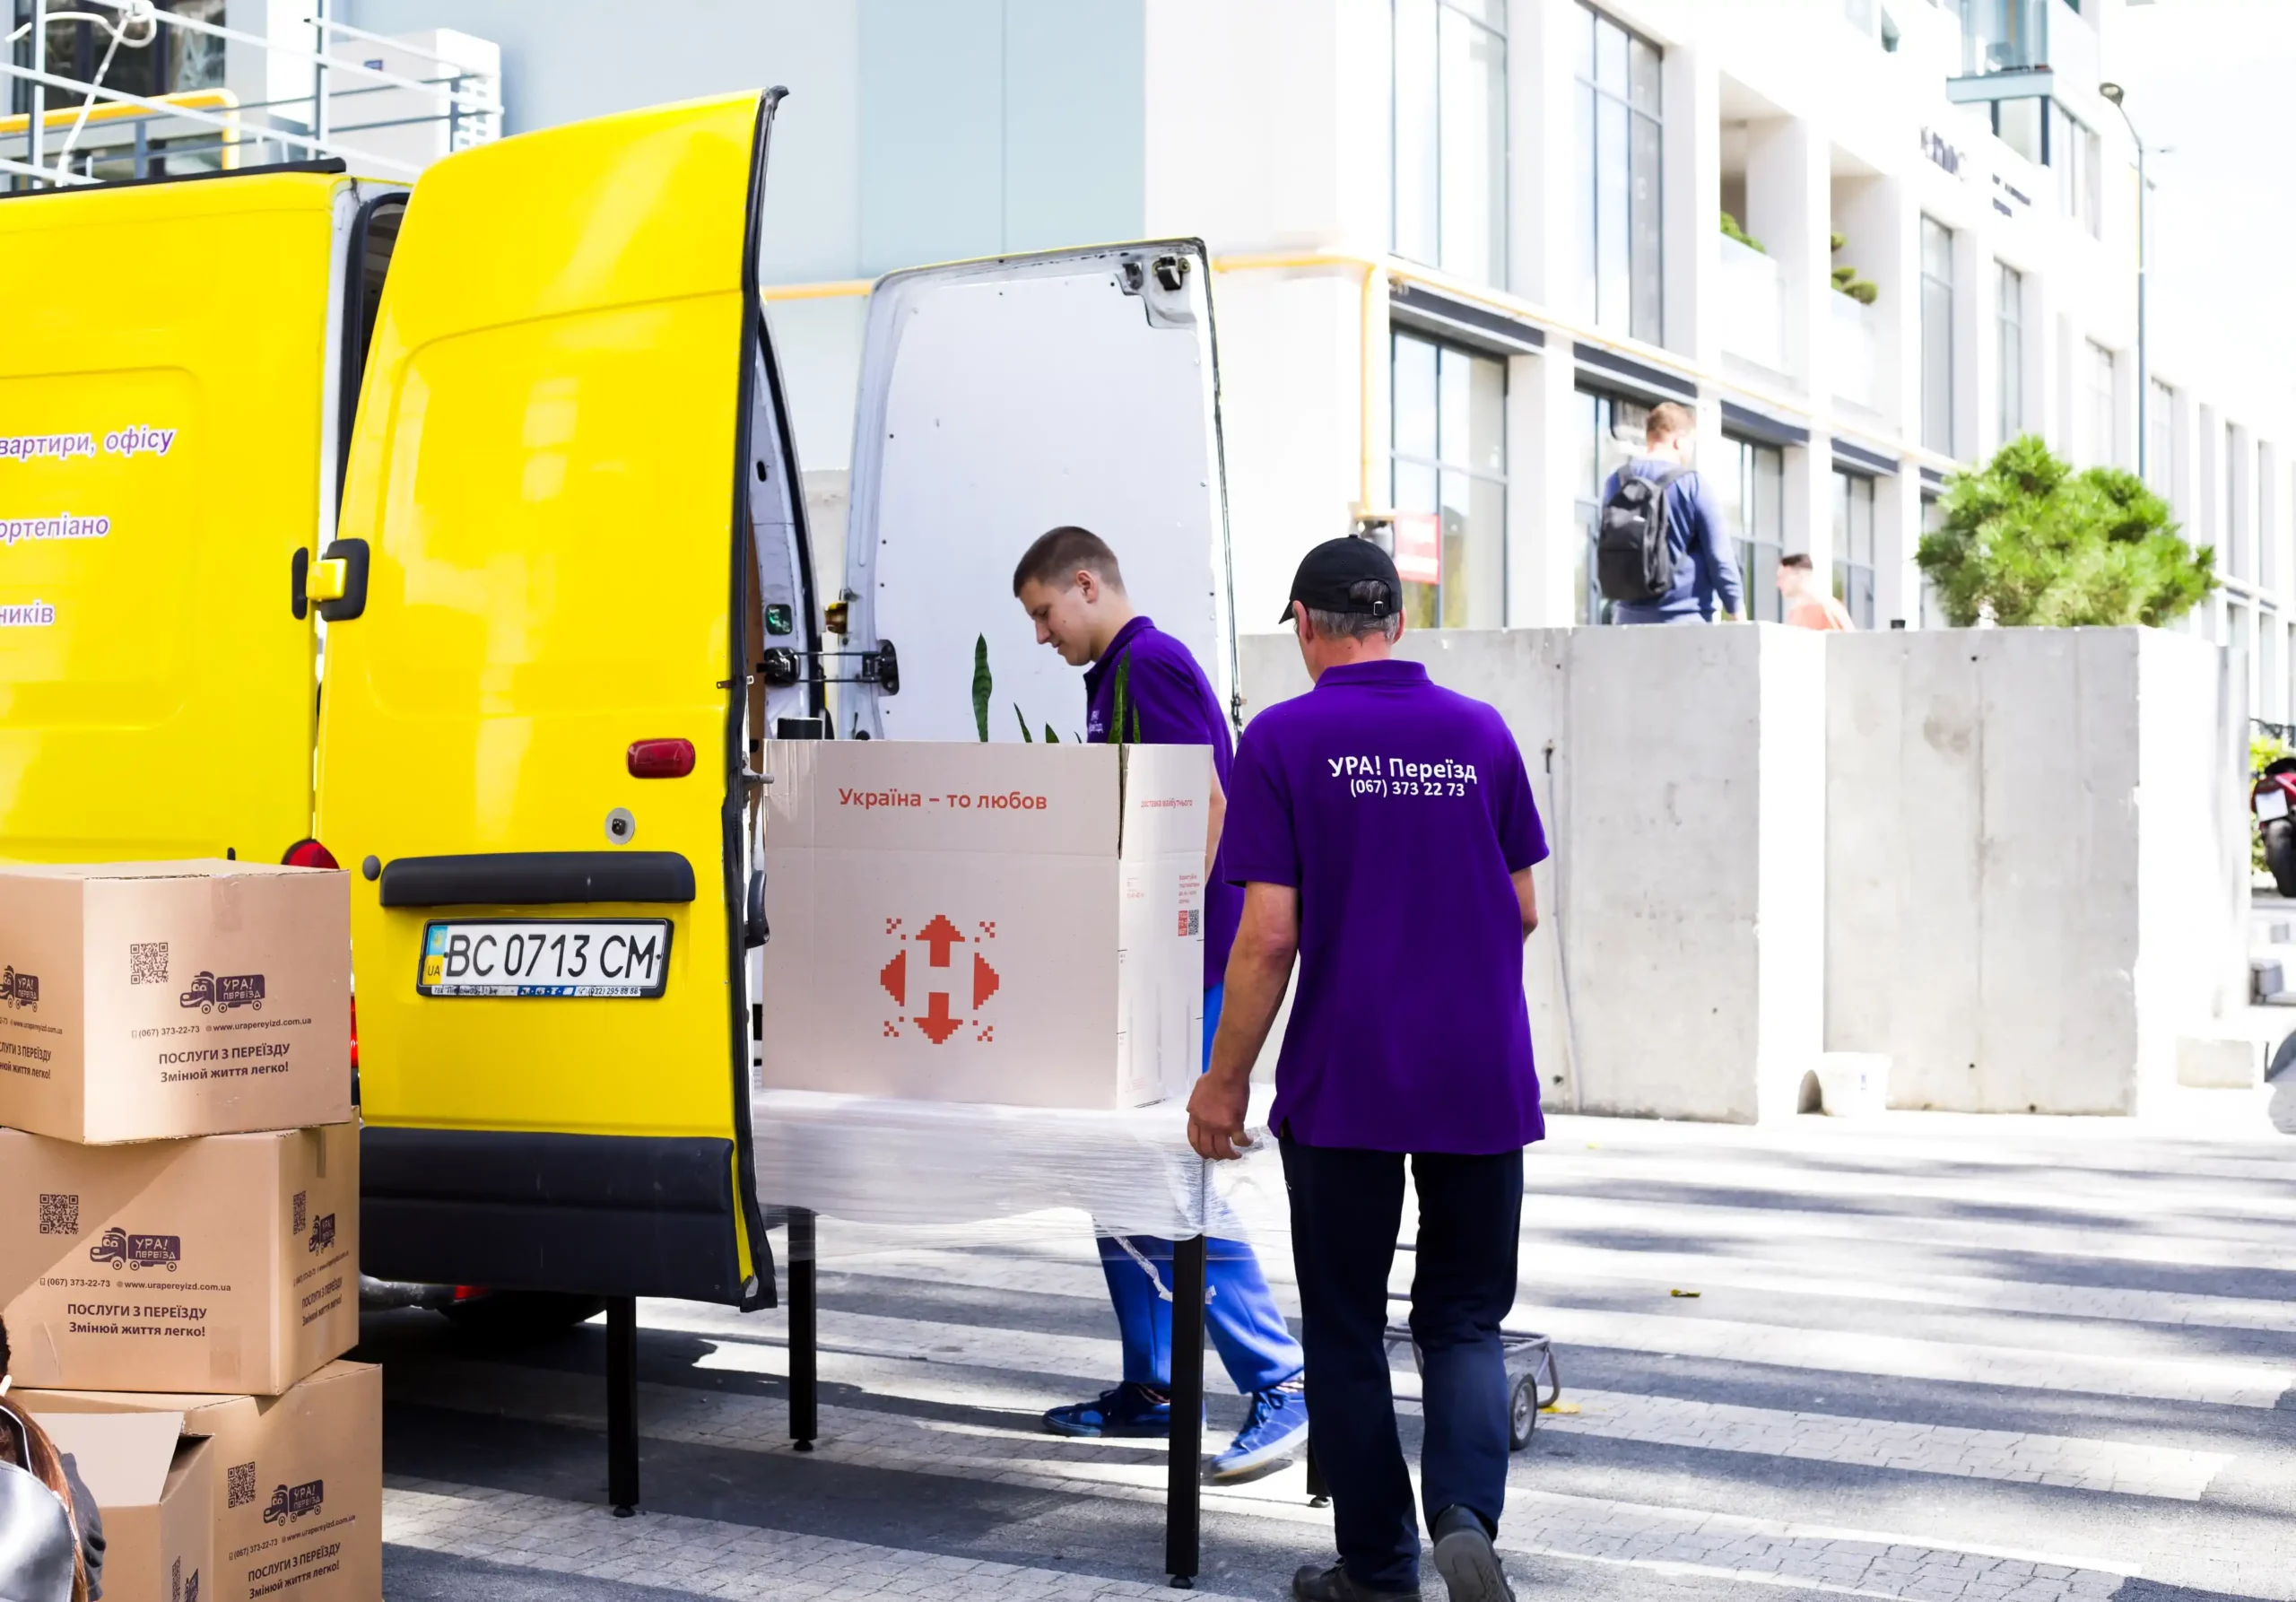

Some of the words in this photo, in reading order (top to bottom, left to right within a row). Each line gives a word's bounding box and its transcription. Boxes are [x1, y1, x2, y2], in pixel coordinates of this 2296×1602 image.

[105, 427, 174, 454] офісу
[1327, 755, 1382, 778] УРА!
[1388, 758, 1478, 784] Переїзд
[839, 788, 921, 810] Україна
[946, 795, 971, 808] то
[976, 791, 1048, 810] любов
[1350, 779, 1387, 798] (067)
[1392, 781, 1419, 796] 373
[1422, 782, 1443, 796] 22
[1446, 782, 1465, 797] 73
[446, 934, 497, 977] BC
[504, 934, 590, 977] 0713
[599, 935, 657, 979] CM
[427, 964, 440, 977] UA
[223, 978, 254, 991] УРА!
[139, 1029, 160, 1039] (067)
[161, 1025, 200, 1036] 373-22-73
[213, 1018, 312, 1032] www.urapereyizd.com.ua
[0, 1041, 17, 1055] ЛУГИ
[22, 1046, 51, 1063] ПЕРЕЇЗДУ
[159, 1049, 219, 1065] ПОСЛУГИ
[231, 1043, 291, 1058] ПЕРЕЇЗДУ
[13, 1065, 30, 1075] життя
[31, 1068, 50, 1079] легко!
[161, 1068, 208, 1083] Змінюй
[210, 1067, 248, 1078] життя
[251, 1061, 289, 1075] легко!
[135, 1238, 169, 1250] УРА!
[48, 1278, 68, 1287] (067)
[70, 1278, 111, 1288] 373-22-73
[124, 1281, 231, 1292] www.urapereyizd.com.ua
[67, 1303, 130, 1317] ПОСЛУГИ
[144, 1304, 207, 1321] ПЕРЕЇЗДУ
[69, 1321, 118, 1334] Змінюй
[121, 1325, 161, 1336] життя
[164, 1326, 205, 1336] легко!
[294, 1484, 316, 1501] УРА!
[233, 1547, 249, 1560] (067)
[249, 1538, 278, 1554] 373-22-73
[286, 1514, 356, 1541] www.urapereyizd.com.ua
[248, 1558, 291, 1582] ПОСЛУГИ
[300, 1542, 342, 1565] ПЕРЕЇЗДУ
[249, 1579, 283, 1599] Змінюй
[284, 1572, 312, 1588] життя
[312, 1560, 340, 1578] легко!
